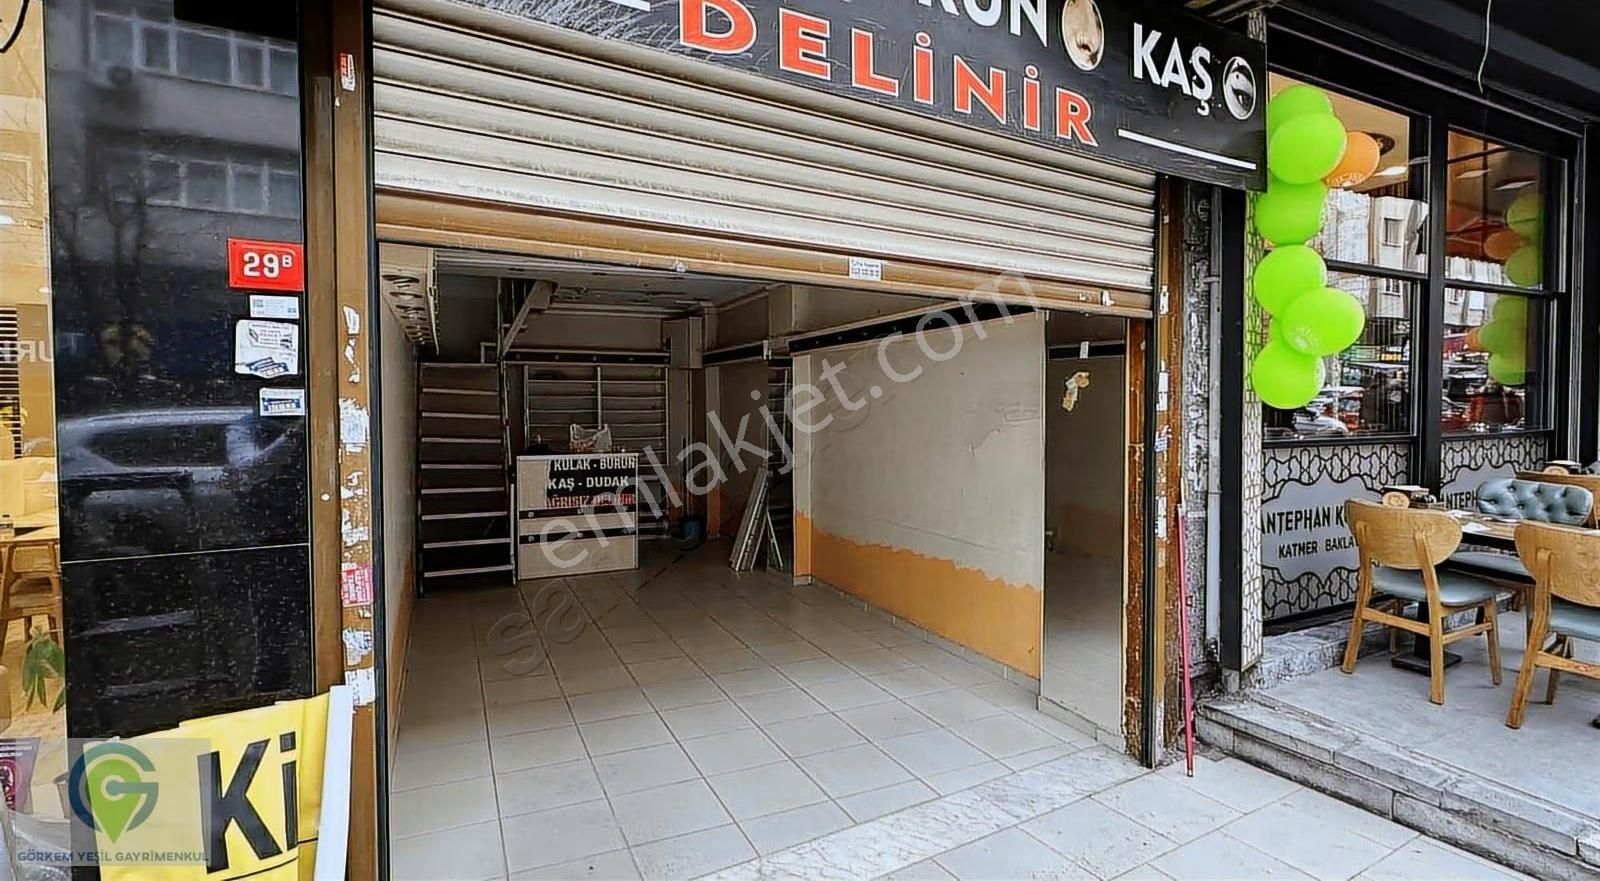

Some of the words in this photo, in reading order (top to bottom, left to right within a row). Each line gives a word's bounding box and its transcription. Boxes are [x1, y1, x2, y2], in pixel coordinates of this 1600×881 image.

[678, 0, 1098, 147] DELİNİR
[1132, 22, 1214, 117] KAŞ
[547, 478, 575, 492] KAŞ
[586, 476, 630, 488] DUDAK
[554, 457, 591, 471] KULAK
